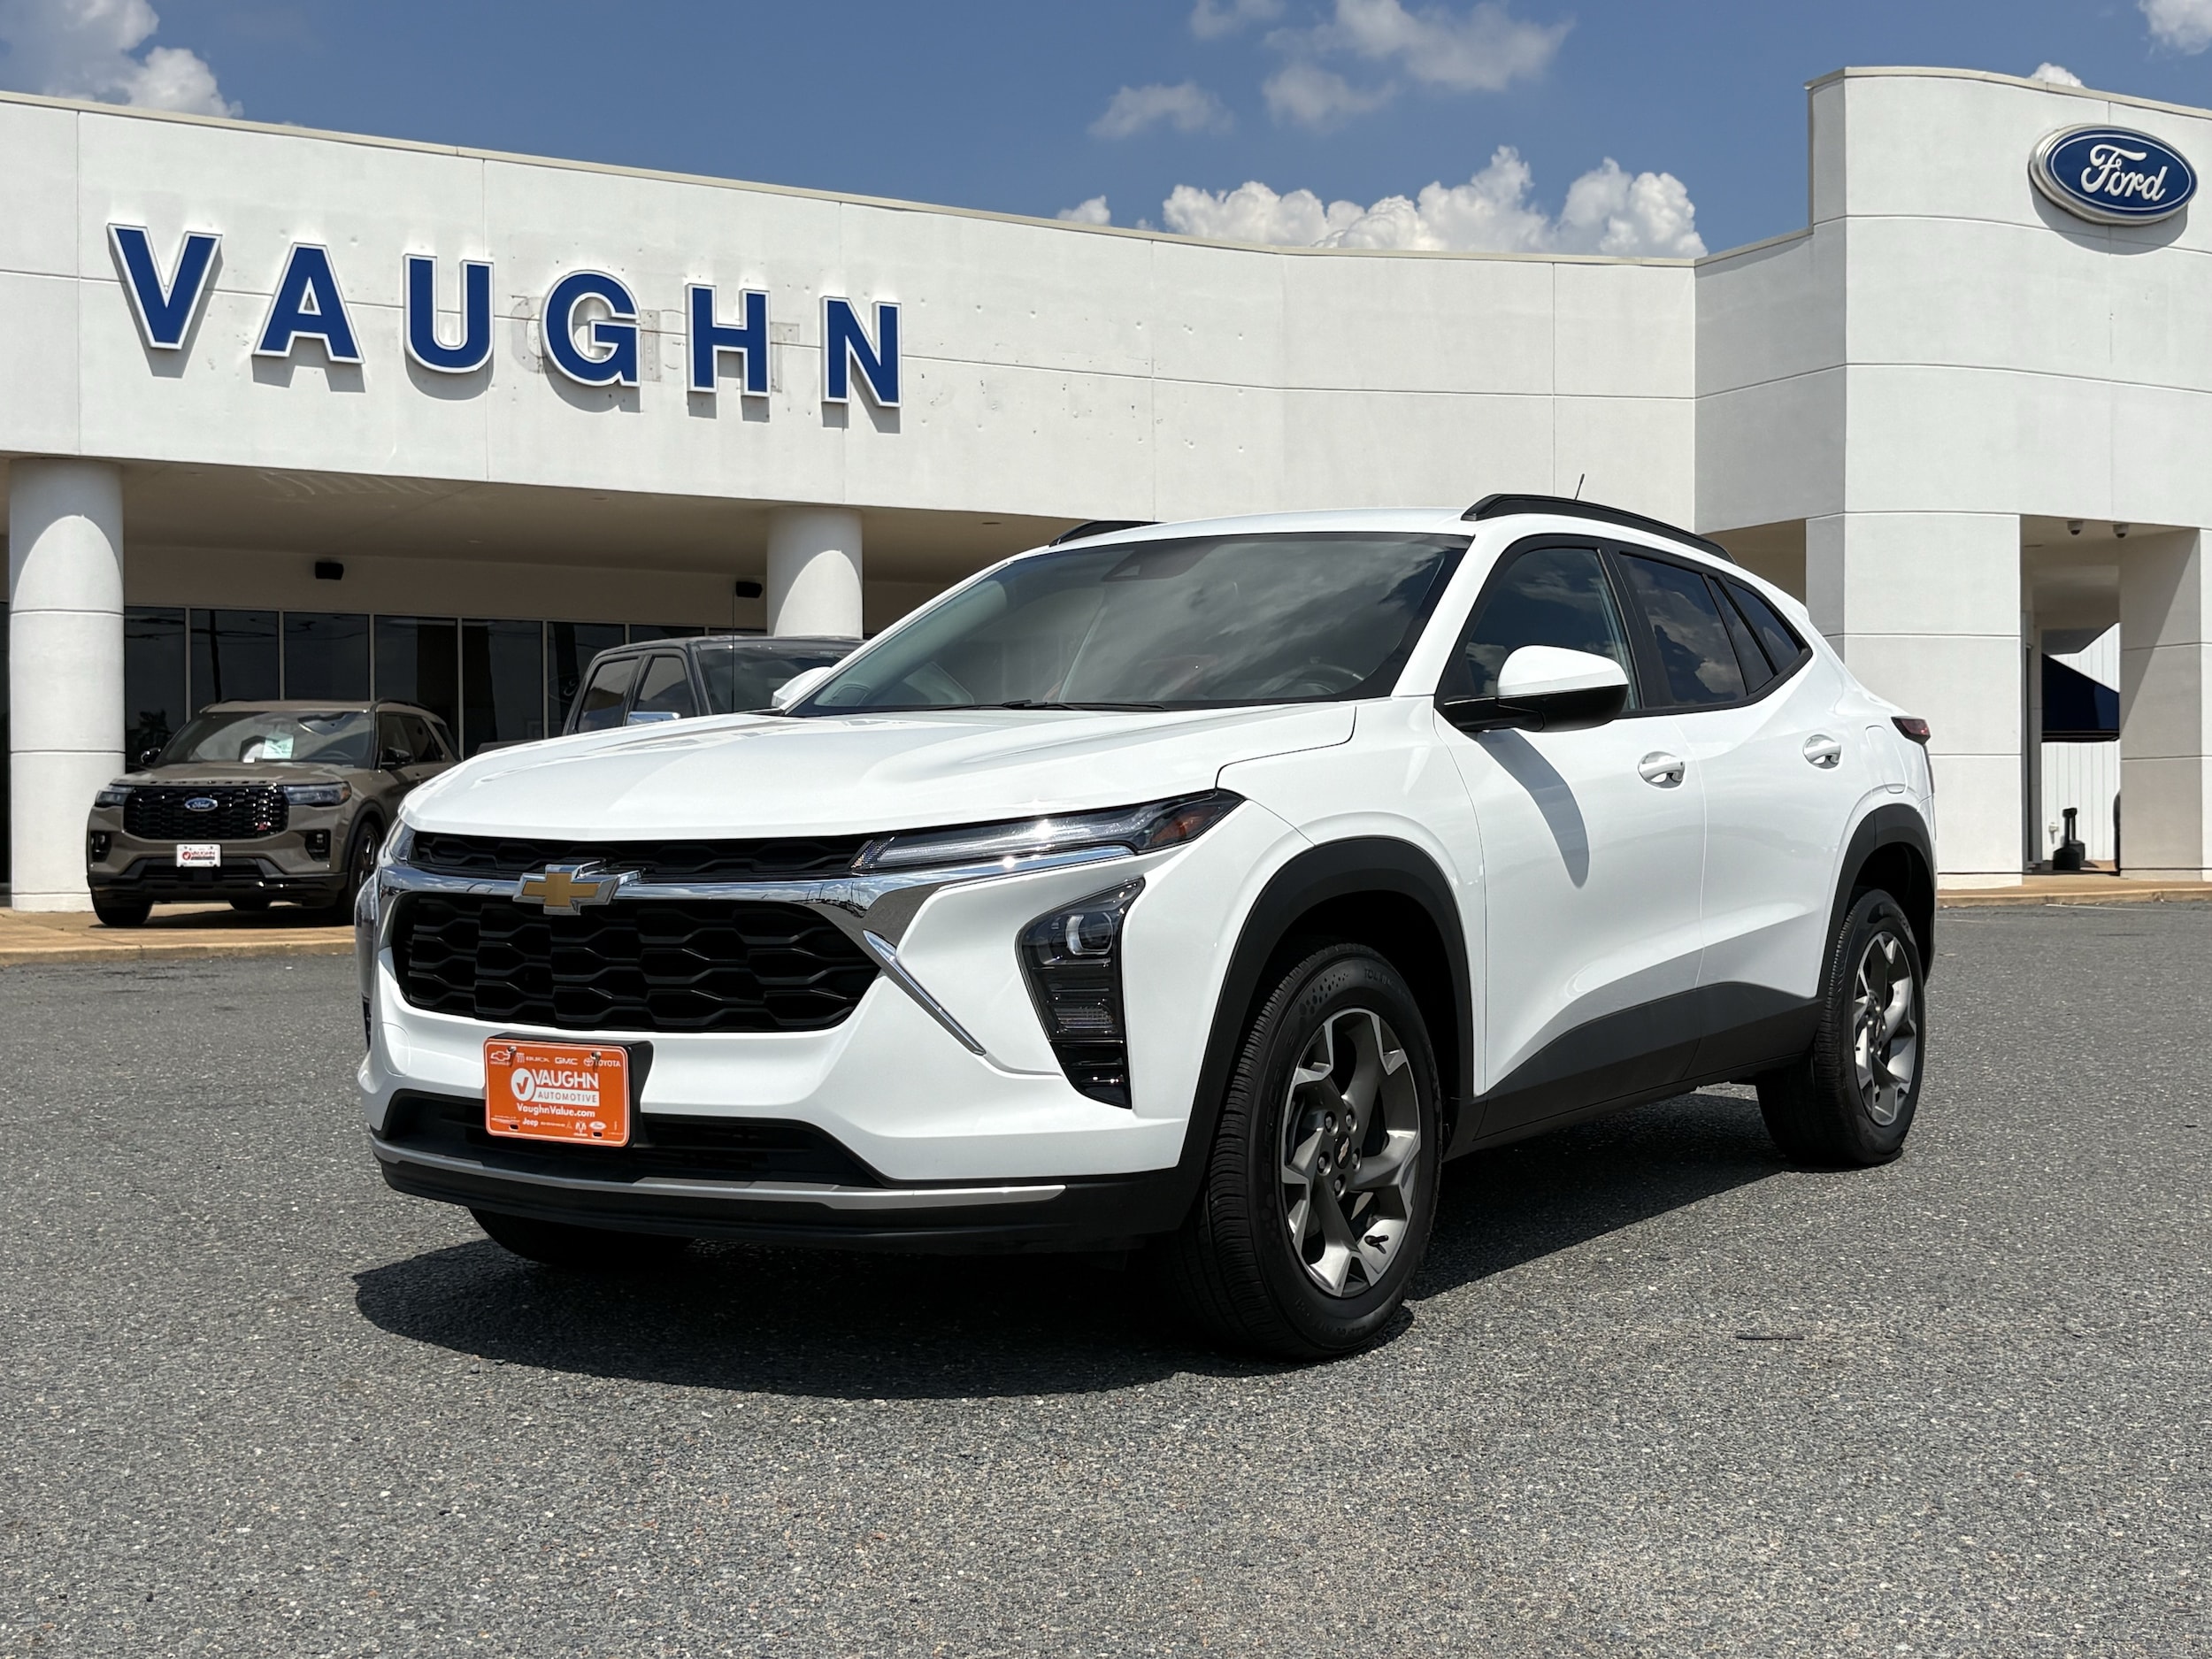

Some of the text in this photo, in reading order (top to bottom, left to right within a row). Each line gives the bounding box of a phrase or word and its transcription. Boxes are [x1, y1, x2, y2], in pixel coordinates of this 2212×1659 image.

[2081, 144, 2168, 202] Ford
[107, 223, 902, 408] VAUGHN
[555, 1056, 579, 1065] GMC
[532, 1068, 599, 1089] VAUGHN
[538, 1091, 597, 1102] AUTOMOTIVE
[517, 1102, 595, 1118] VaughnValue.com
[522, 1118, 539, 1127] Jeep
